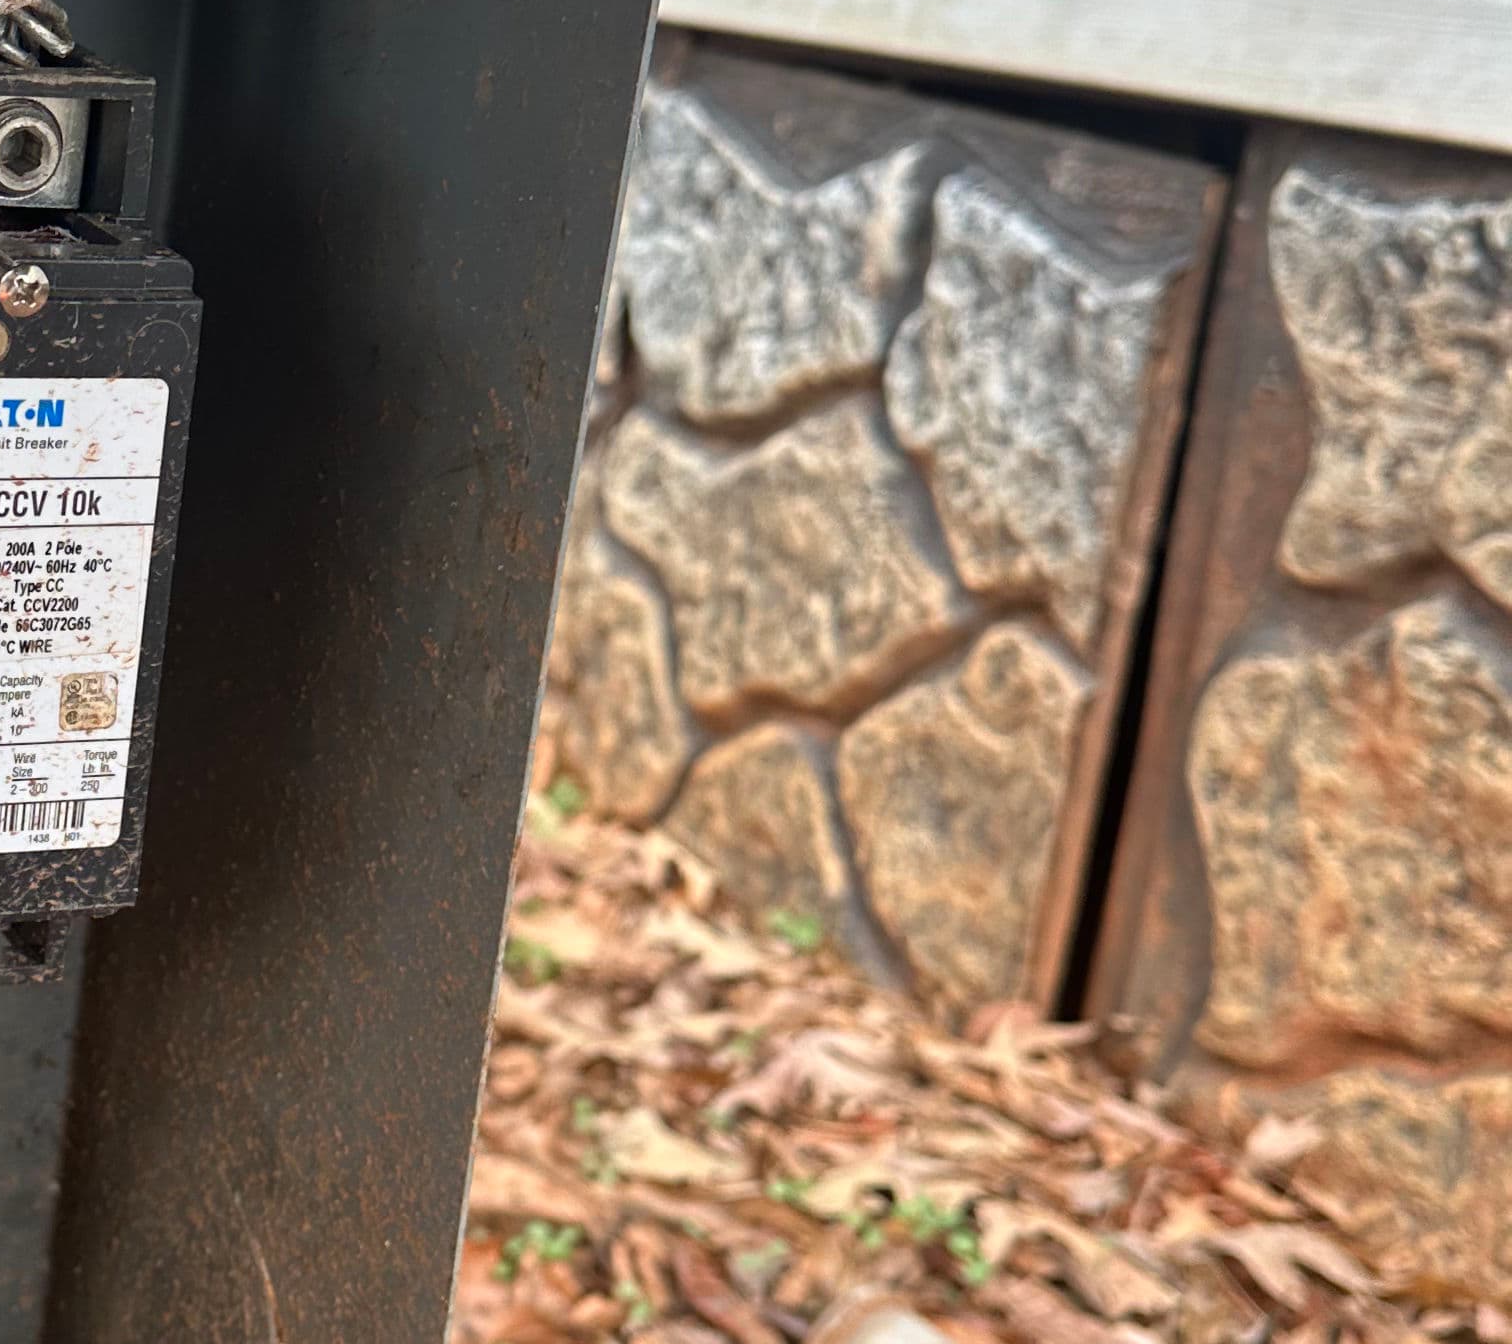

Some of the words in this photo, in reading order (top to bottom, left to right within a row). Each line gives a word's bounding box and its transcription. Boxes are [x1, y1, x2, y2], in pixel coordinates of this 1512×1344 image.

[15, 436, 69, 450] Breaker
[56, 487, 102, 517] 10k
[6, 542, 35, 556] 200A
[45, 541, 52, 556] 2
[56, 541, 83, 555] Pole
[46, 560, 76, 574] 60Hz
[83, 558, 112, 573] 40°C
[14, 579, 43, 596] Type
[46, 578, 64, 593] CC
[23, 597, 79, 613] CCV2200
[19, 639, 53, 654] WIRE
[0, 675, 43, 688] Capacity
[11, 707, 24, 718] kA
[10, 724, 23, 736] 10
[83, 749, 118, 762] Torque
[12, 767, 33, 778] Size
[10, 784, 18, 796] 2
[80, 780, 100, 792] 250
